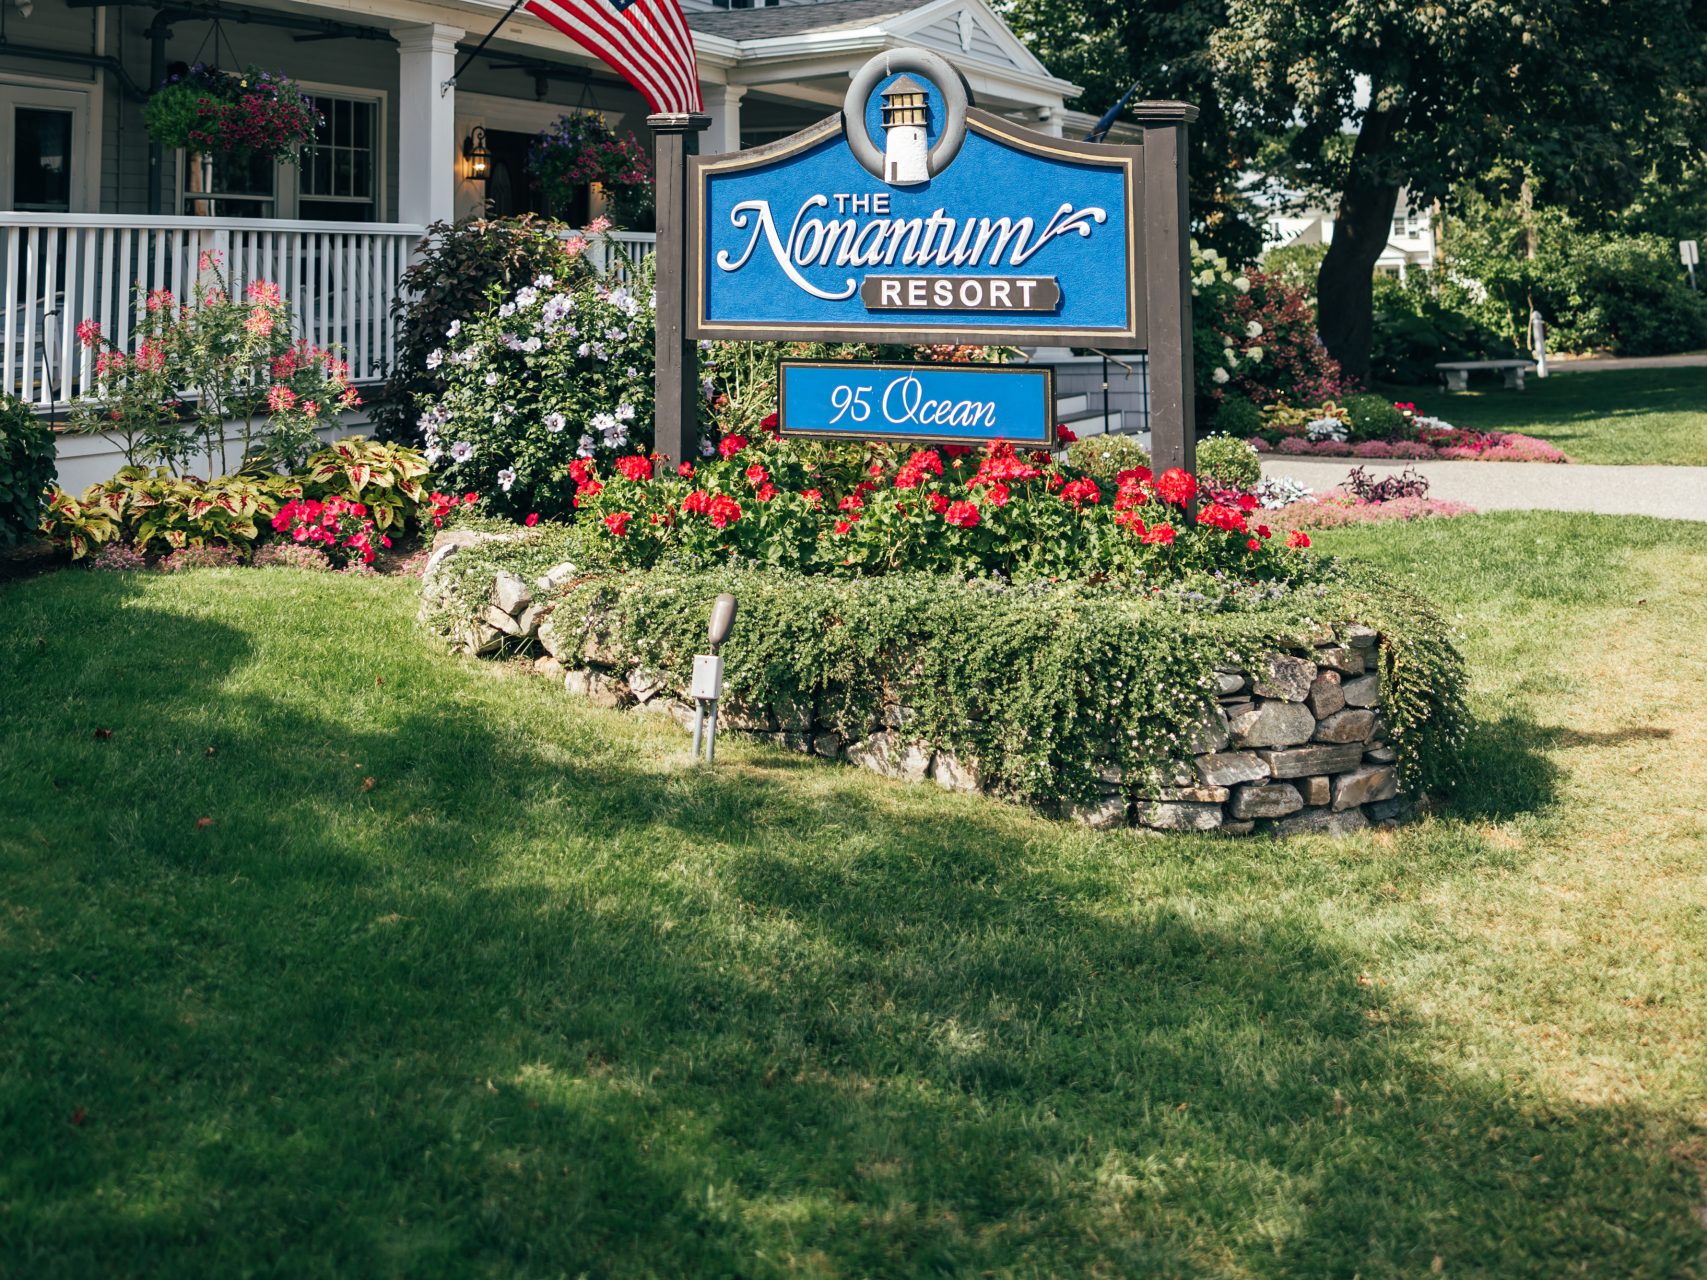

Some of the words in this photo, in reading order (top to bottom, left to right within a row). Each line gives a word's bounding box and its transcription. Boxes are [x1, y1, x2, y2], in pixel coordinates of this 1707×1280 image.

[834, 192, 891, 214] THE
[716, 194, 1107, 300] Nonantum
[881, 279, 1037, 307] RESORT
[829, 385, 873, 425] 95
[882, 375, 996, 427] Ocean
